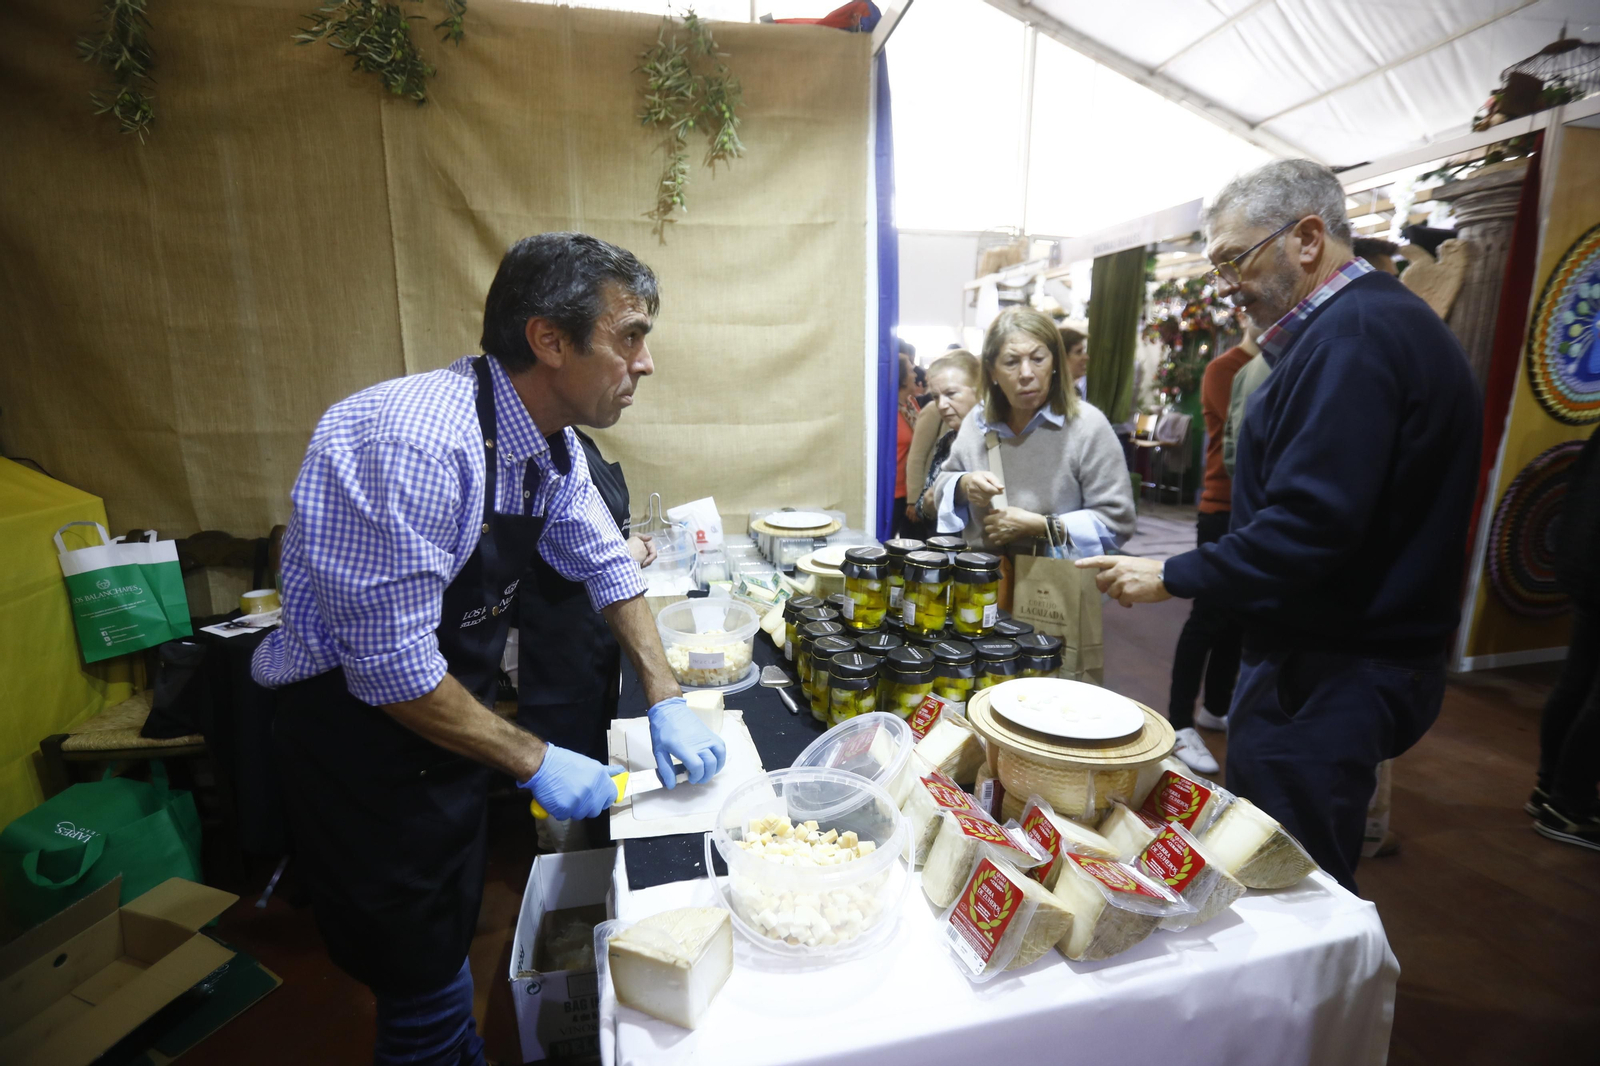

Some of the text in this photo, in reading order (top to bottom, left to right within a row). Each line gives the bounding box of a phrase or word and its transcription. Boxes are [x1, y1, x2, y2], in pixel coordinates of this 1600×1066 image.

[1028, 599, 1057, 609] CORTIJO
[1155, 842, 1171, 858] SIERRA
[1151, 845, 1158, 853] DE
[1157, 852, 1178, 875] ZUHEROS
[981, 883, 995, 898] SIERRA
[977, 888, 985, 896] DE
[983, 893, 1001, 915] ZUHEROS
[564, 998, 587, 1013] BAG
